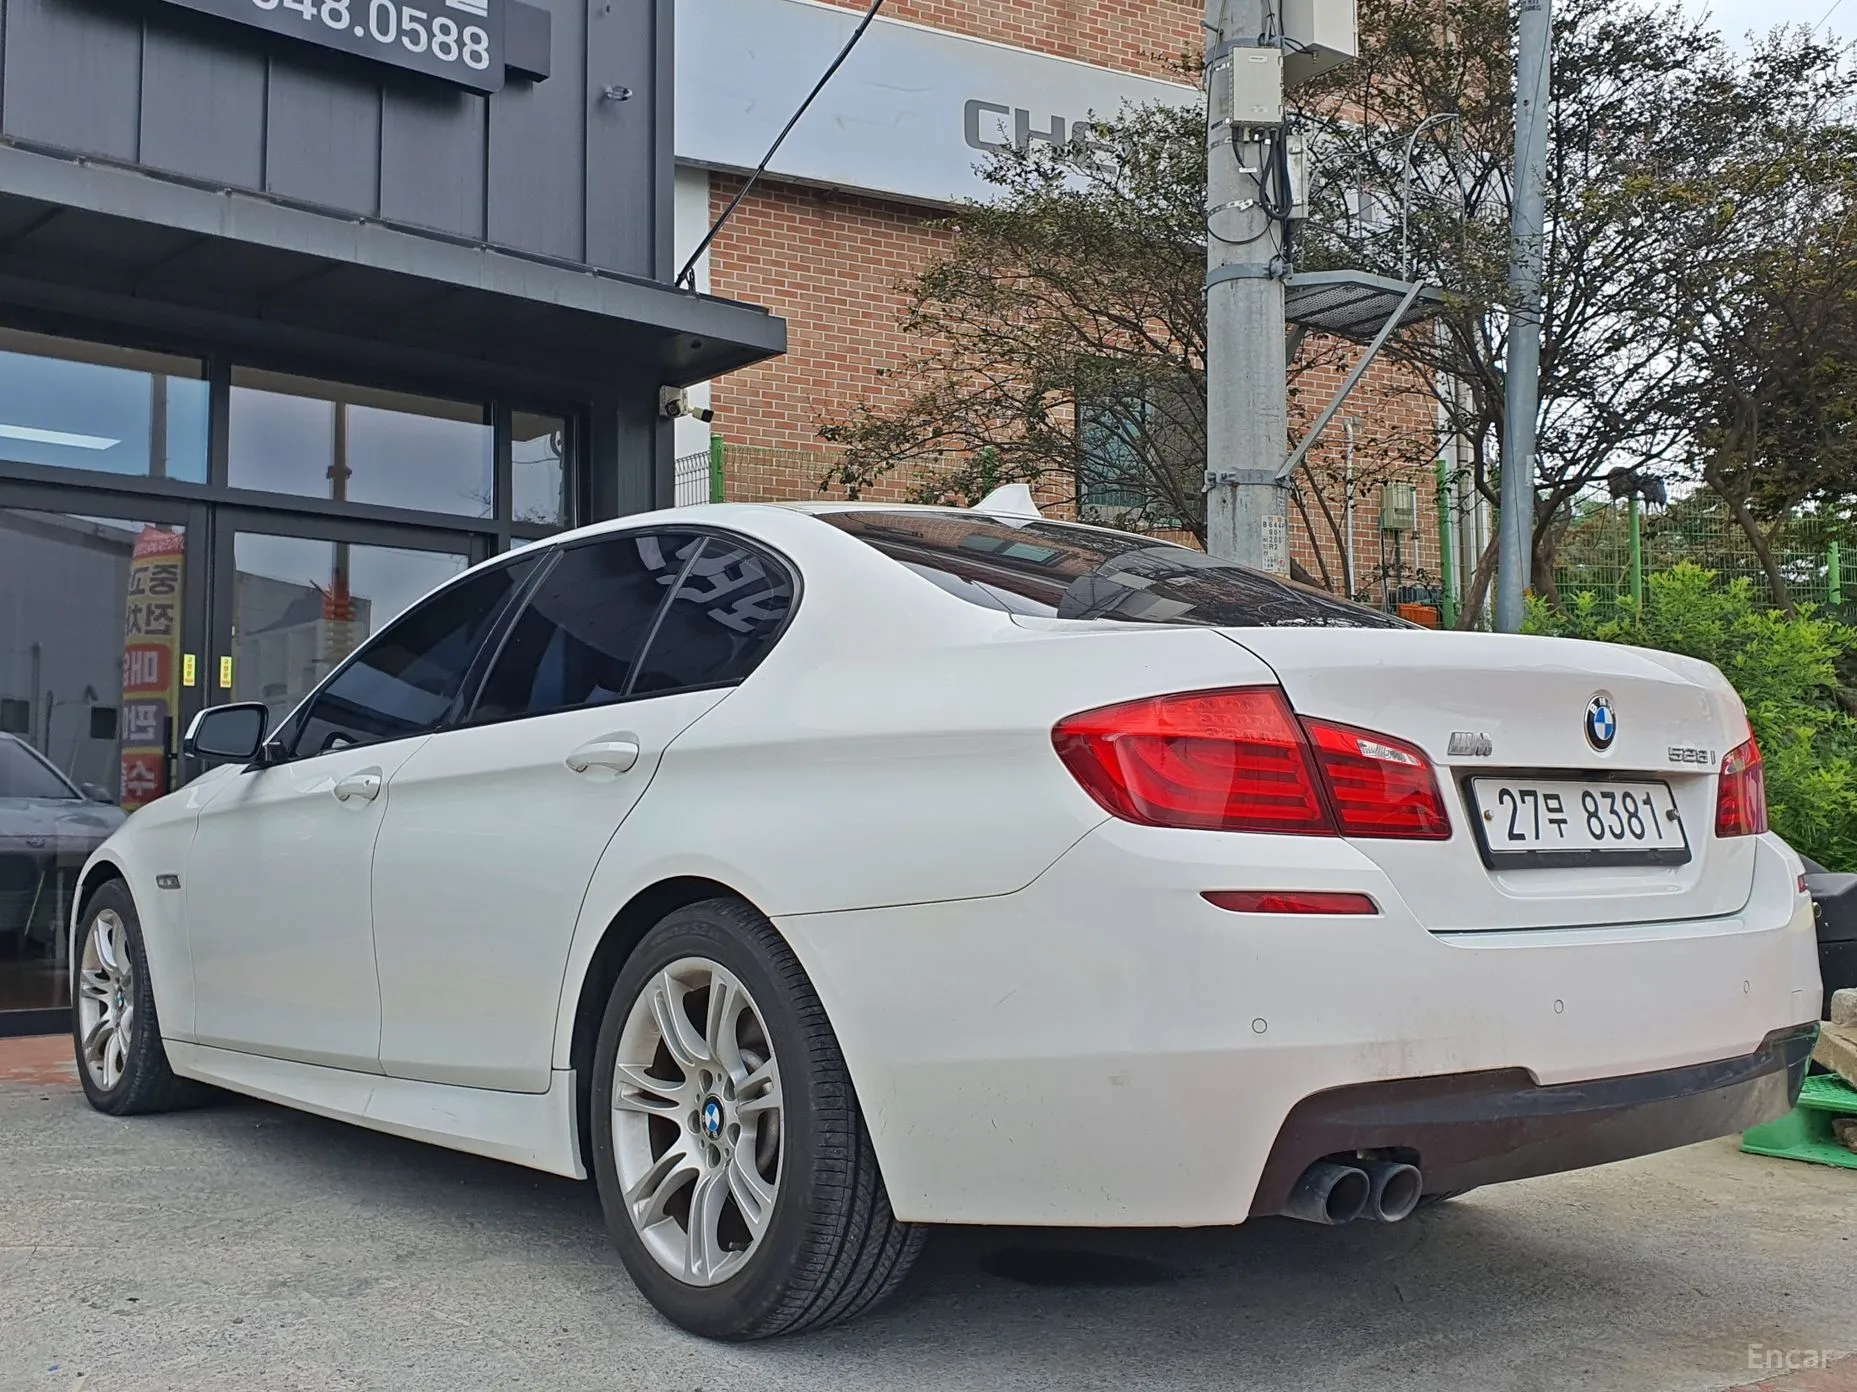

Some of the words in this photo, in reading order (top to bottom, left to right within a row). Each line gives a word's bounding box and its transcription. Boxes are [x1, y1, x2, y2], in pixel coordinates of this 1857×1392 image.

[253, 0, 490, 71] 8.0588
[964, 99, 1128, 175] CHE
[1499, 787, 1568, 841] 27무
[1581, 789, 1663, 841] 8381
